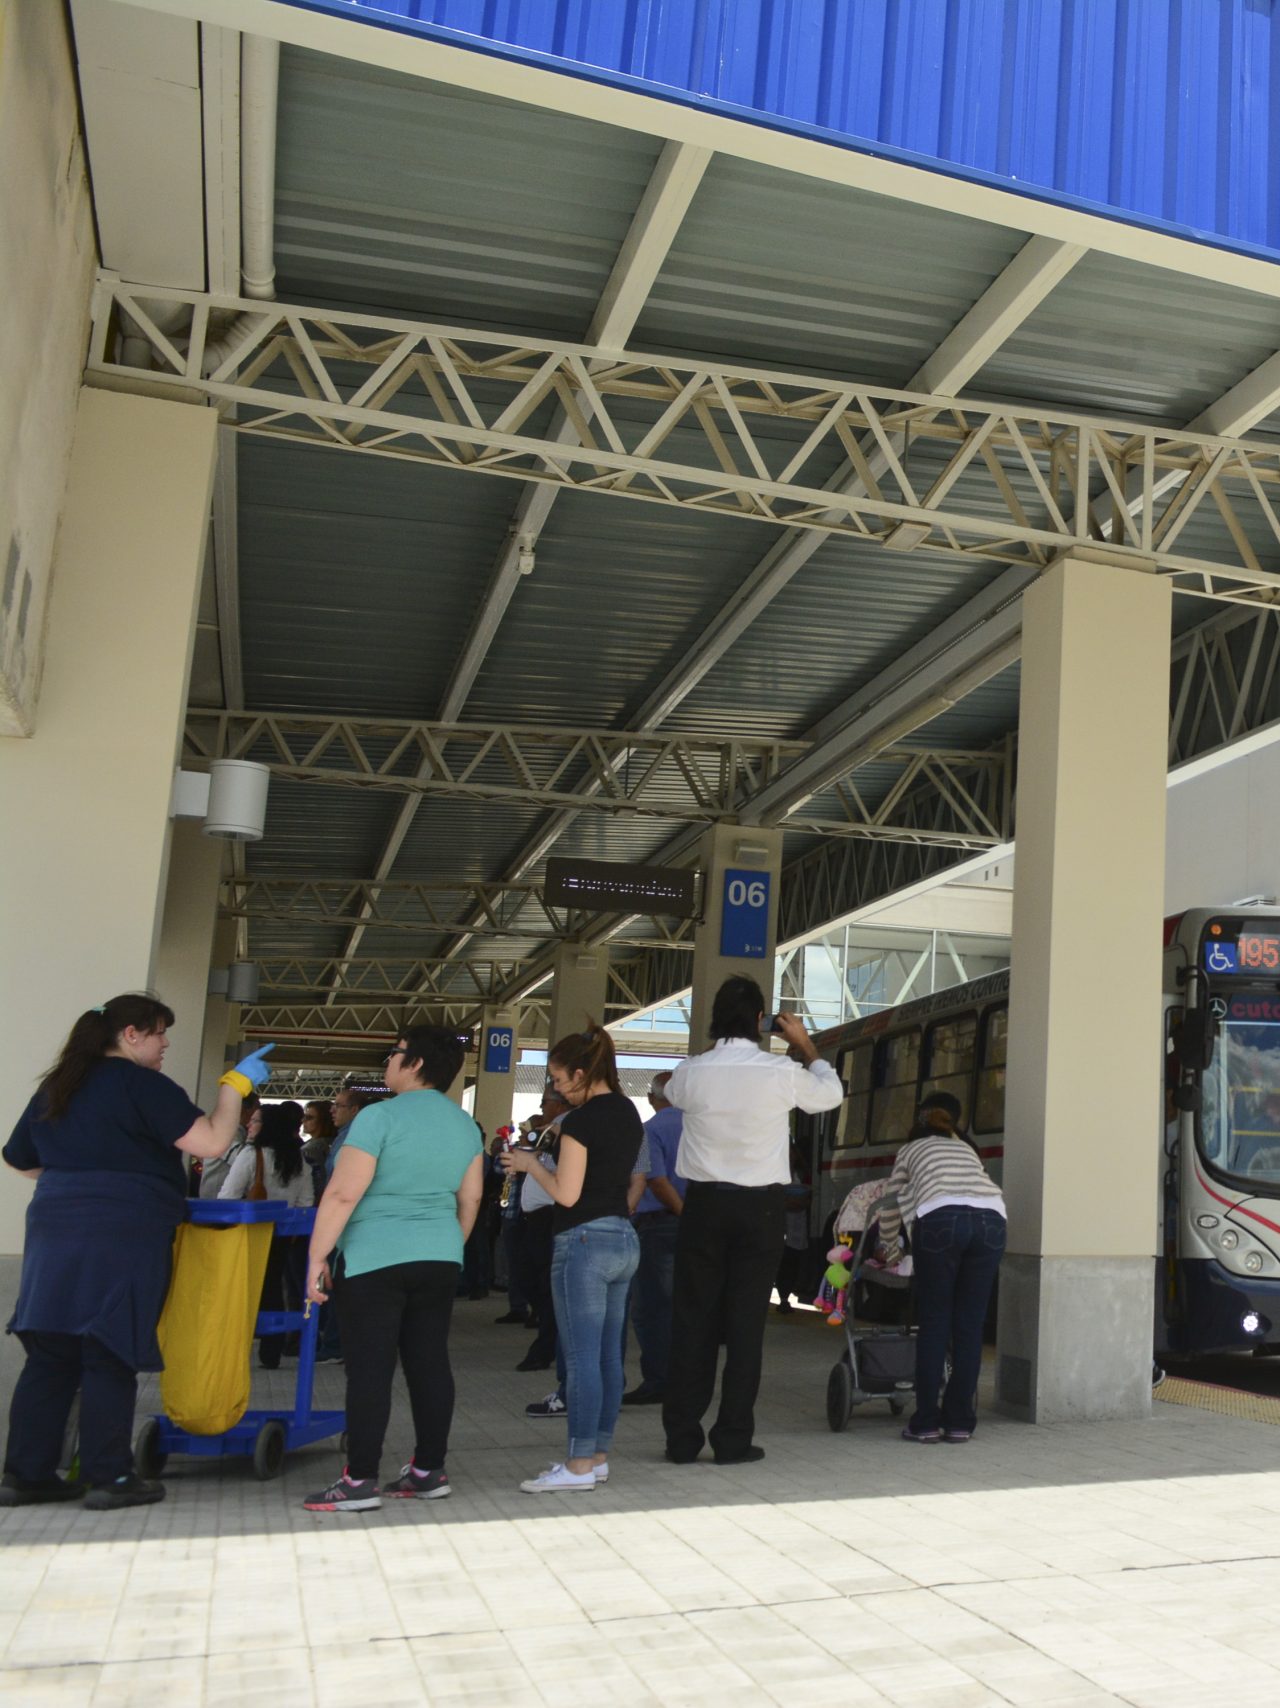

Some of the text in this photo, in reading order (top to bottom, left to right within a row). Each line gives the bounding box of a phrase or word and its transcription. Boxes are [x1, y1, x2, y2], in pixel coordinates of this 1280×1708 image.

[728, 879, 766, 908] 06
[1239, 937, 1280, 968] 195
[490, 1033, 510, 1047] 06
